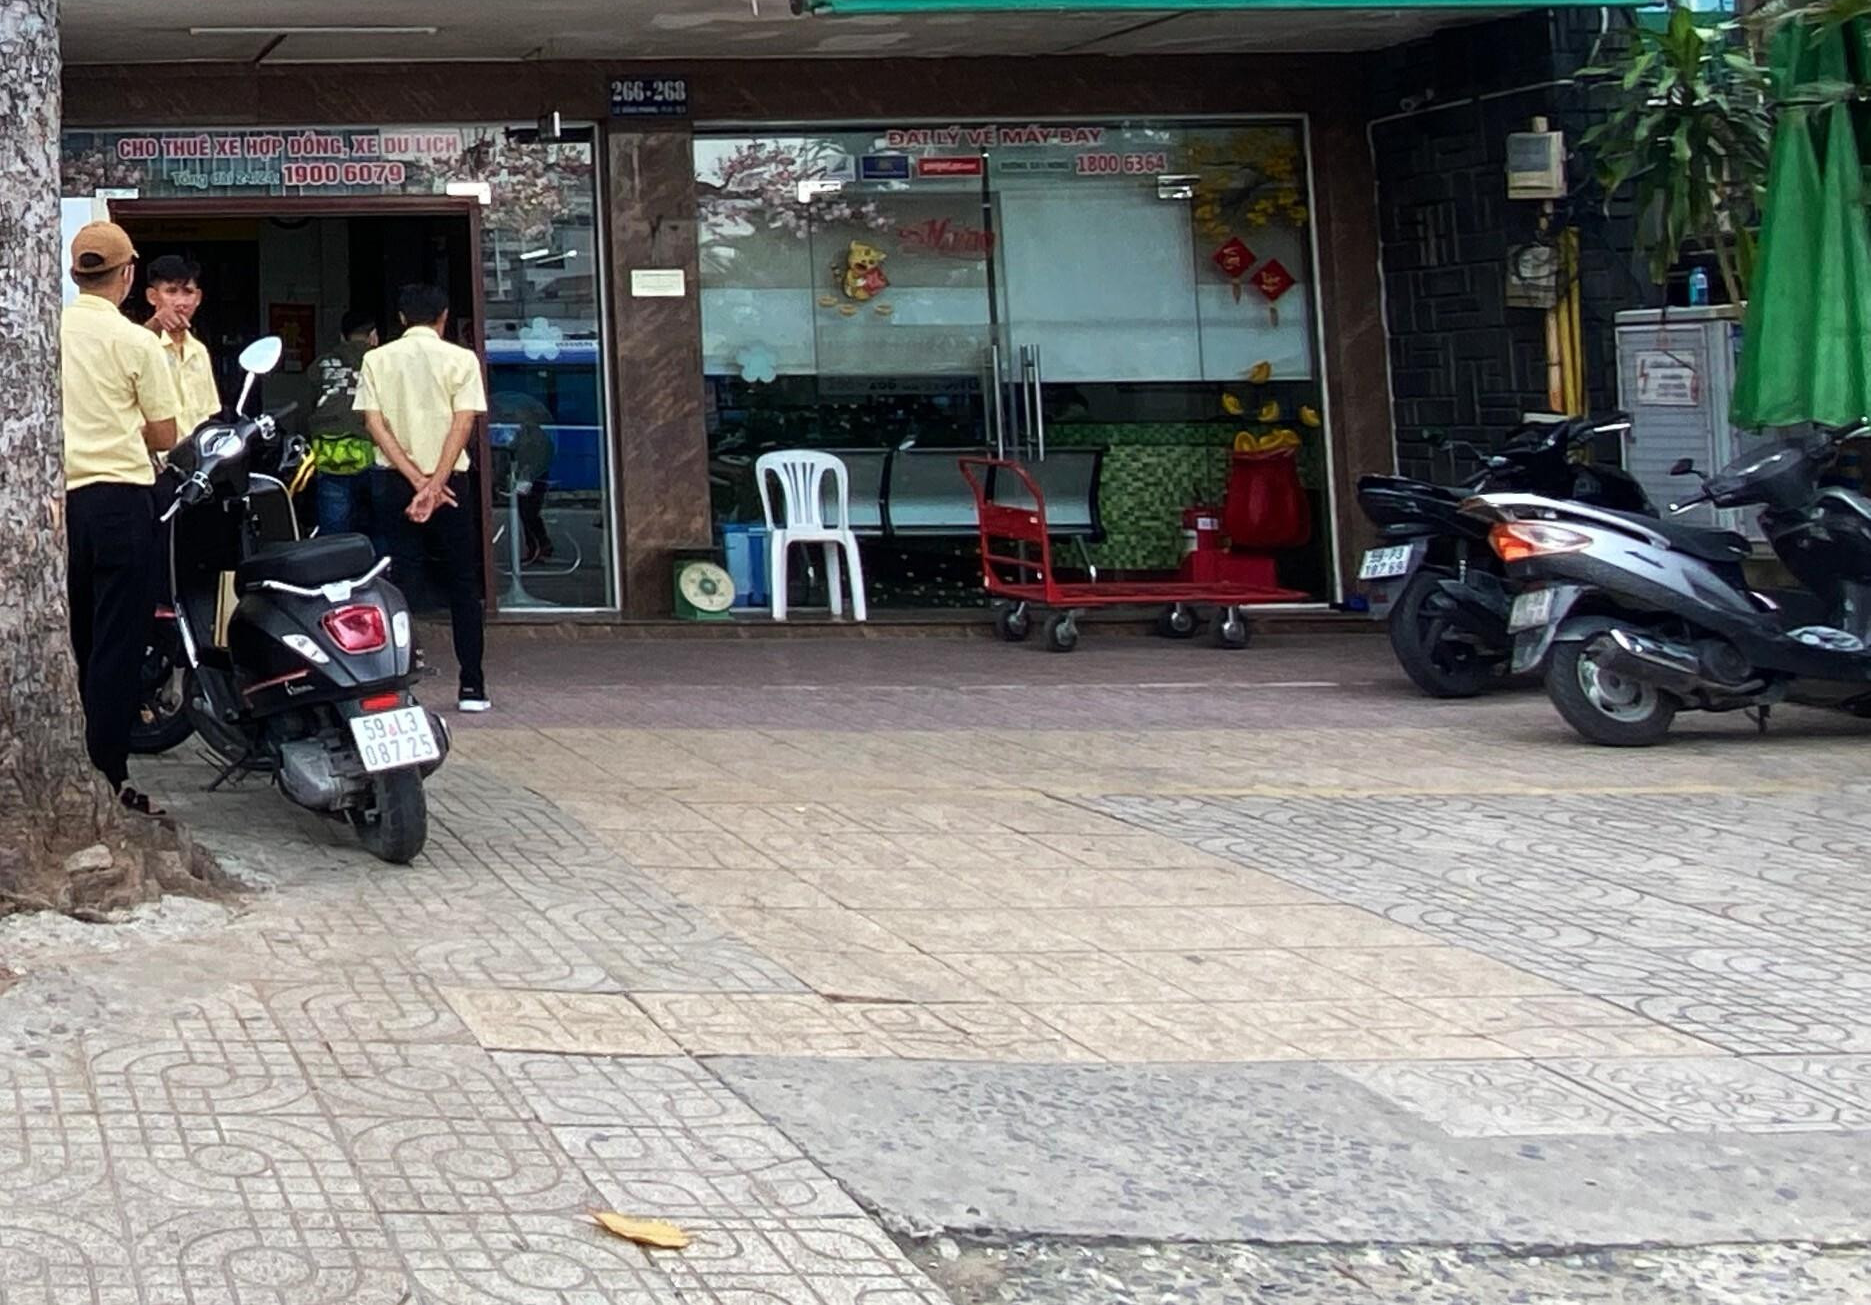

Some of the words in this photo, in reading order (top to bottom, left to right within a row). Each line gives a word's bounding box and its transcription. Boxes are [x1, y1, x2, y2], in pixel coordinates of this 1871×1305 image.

[934, 126, 960, 145] LÝ
[1059, 128, 1104, 145] BAY
[119, 137, 159, 159] CHO
[163, 134, 209, 157] THUÊ
[215, 137, 240, 157] XE
[244, 135, 284, 161] HỢP
[352, 135, 378, 156] XE
[384, 134, 411, 155] DU
[282, 163, 337, 185] 1900
[342, 162, 405, 185] 6079
[1077, 155, 1117, 175] 1800
[1123, 154, 1166, 173] 6364
